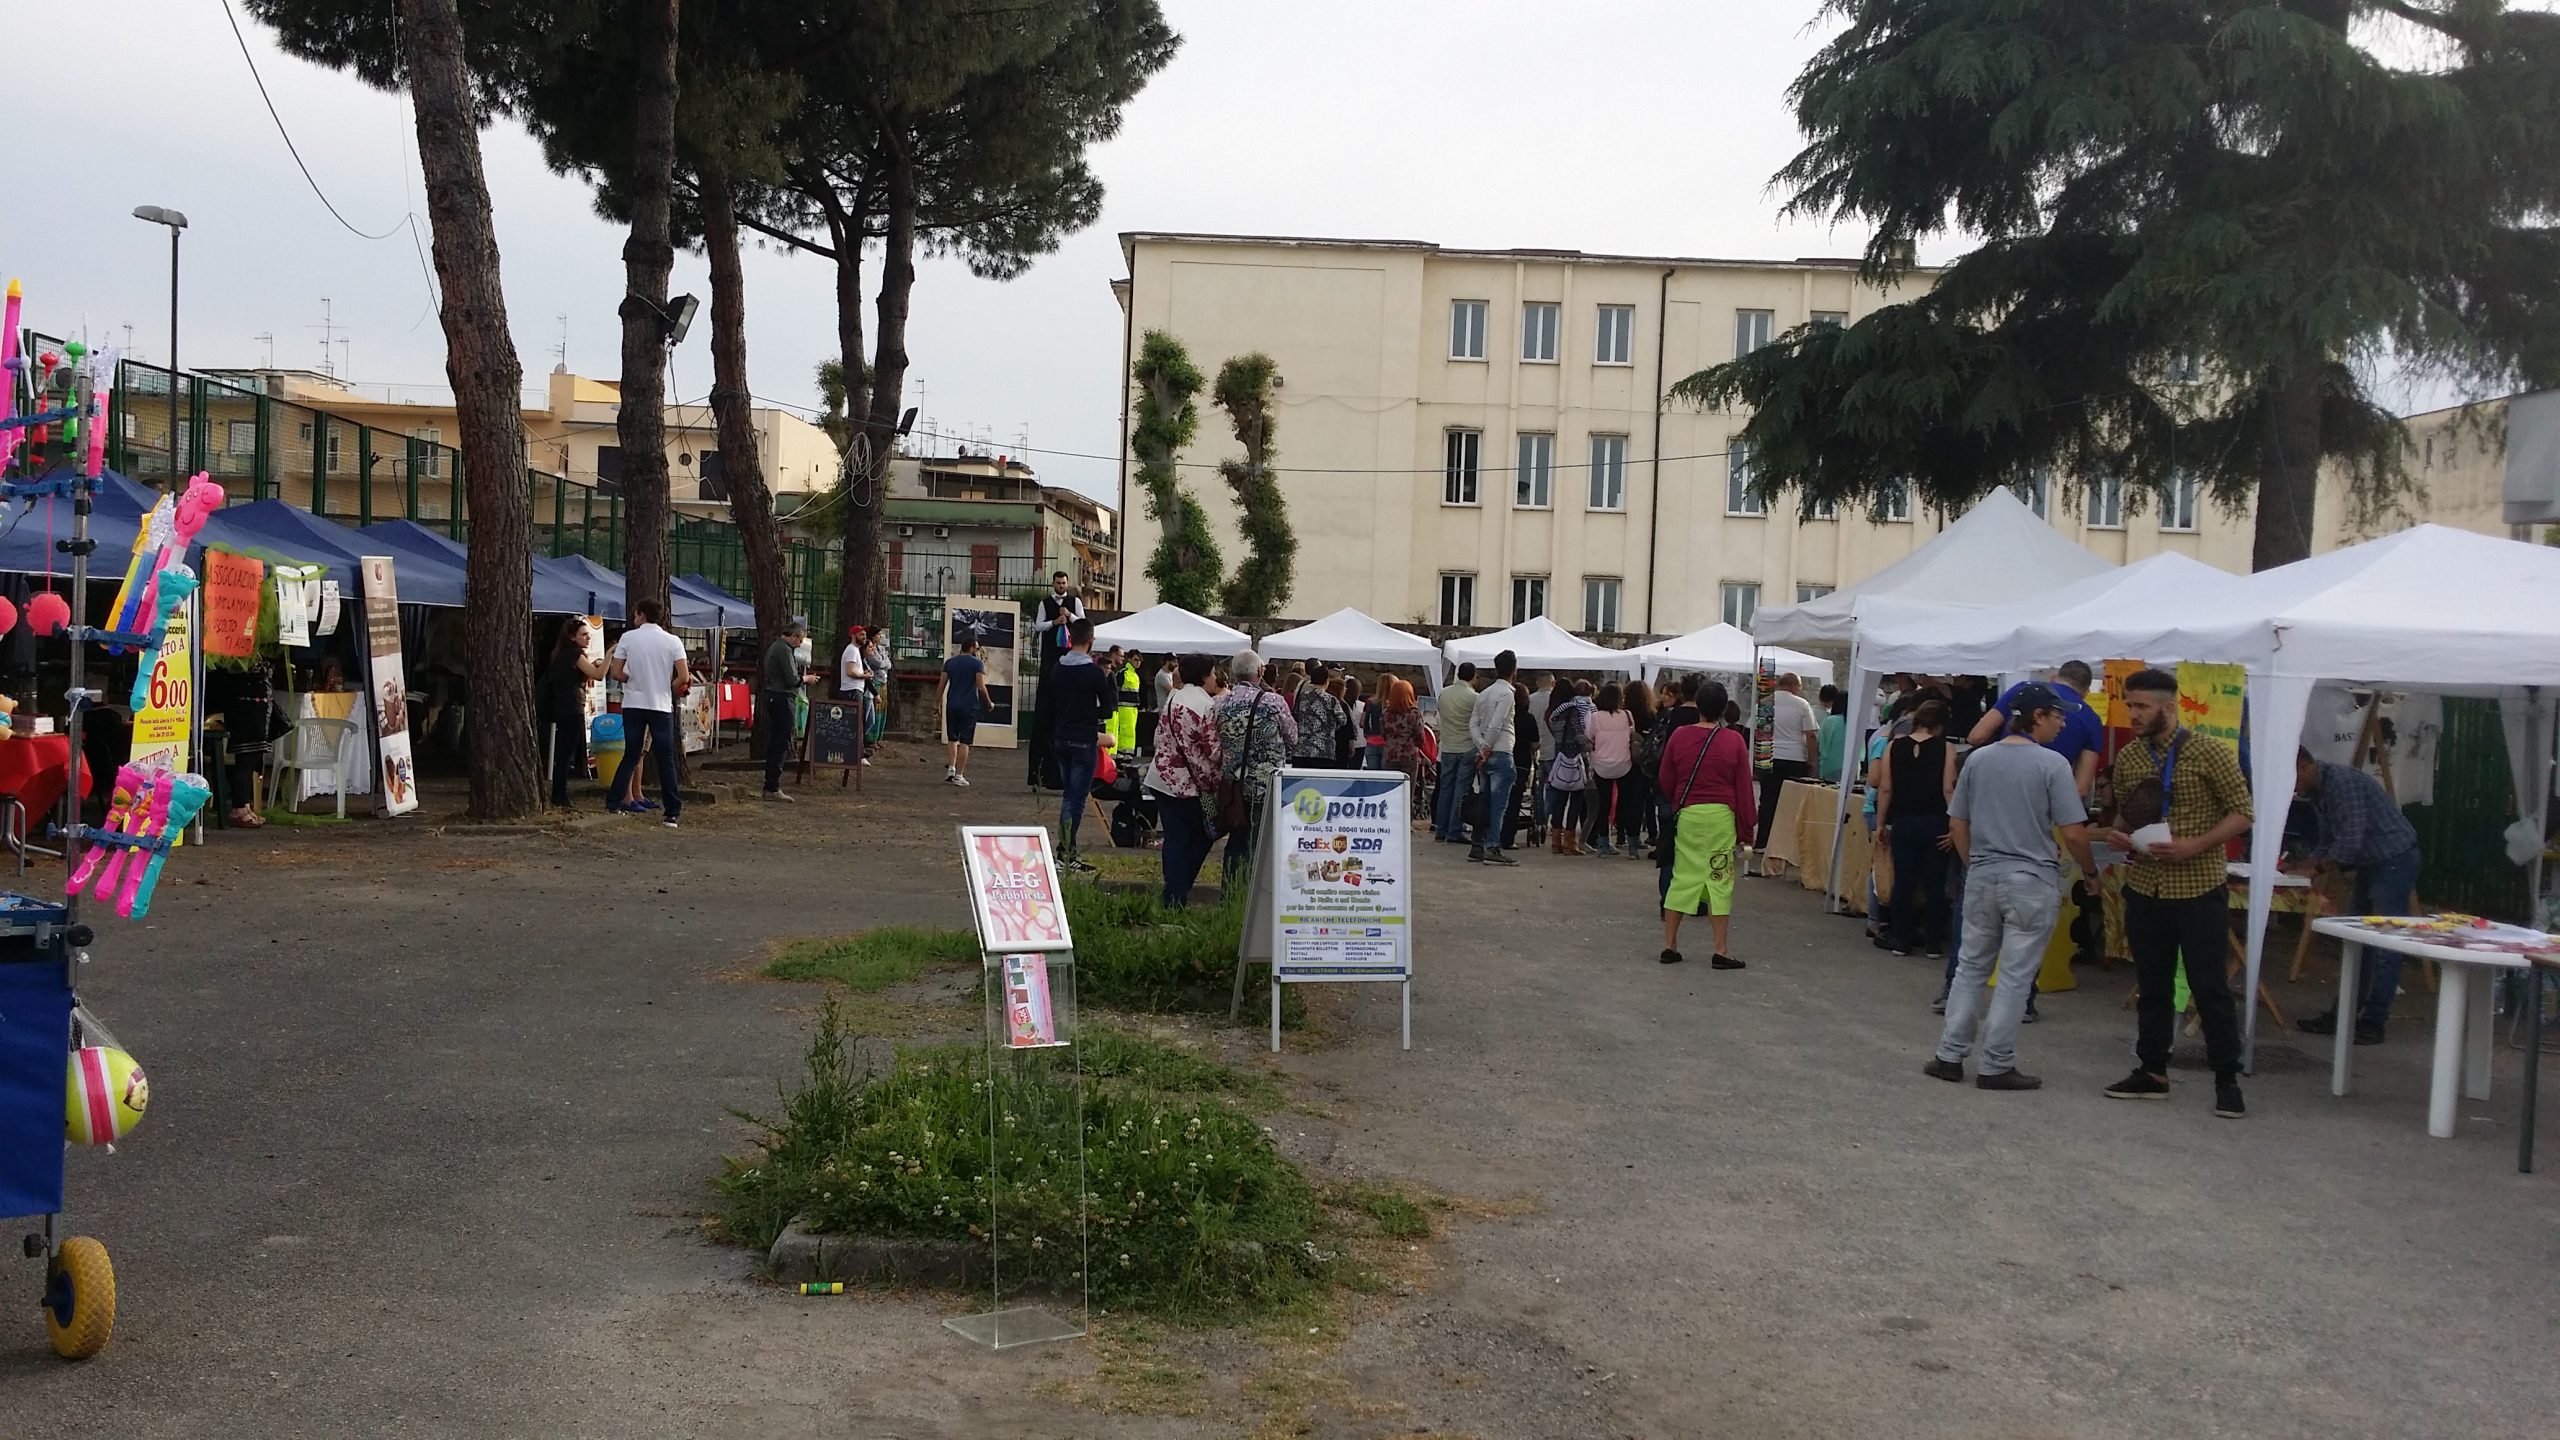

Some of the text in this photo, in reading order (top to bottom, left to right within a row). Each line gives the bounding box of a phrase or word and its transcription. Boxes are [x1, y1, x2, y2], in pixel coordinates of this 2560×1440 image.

[1298, 796, 1388, 822] ki point
[1304, 825, 1324, 833] Rossi,
[1377, 827, 1391, 835] (Na)
[1298, 838, 1330, 850] FedEx
[1333, 840, 1347, 850] ups
[1350, 838, 1383, 851] SDA
